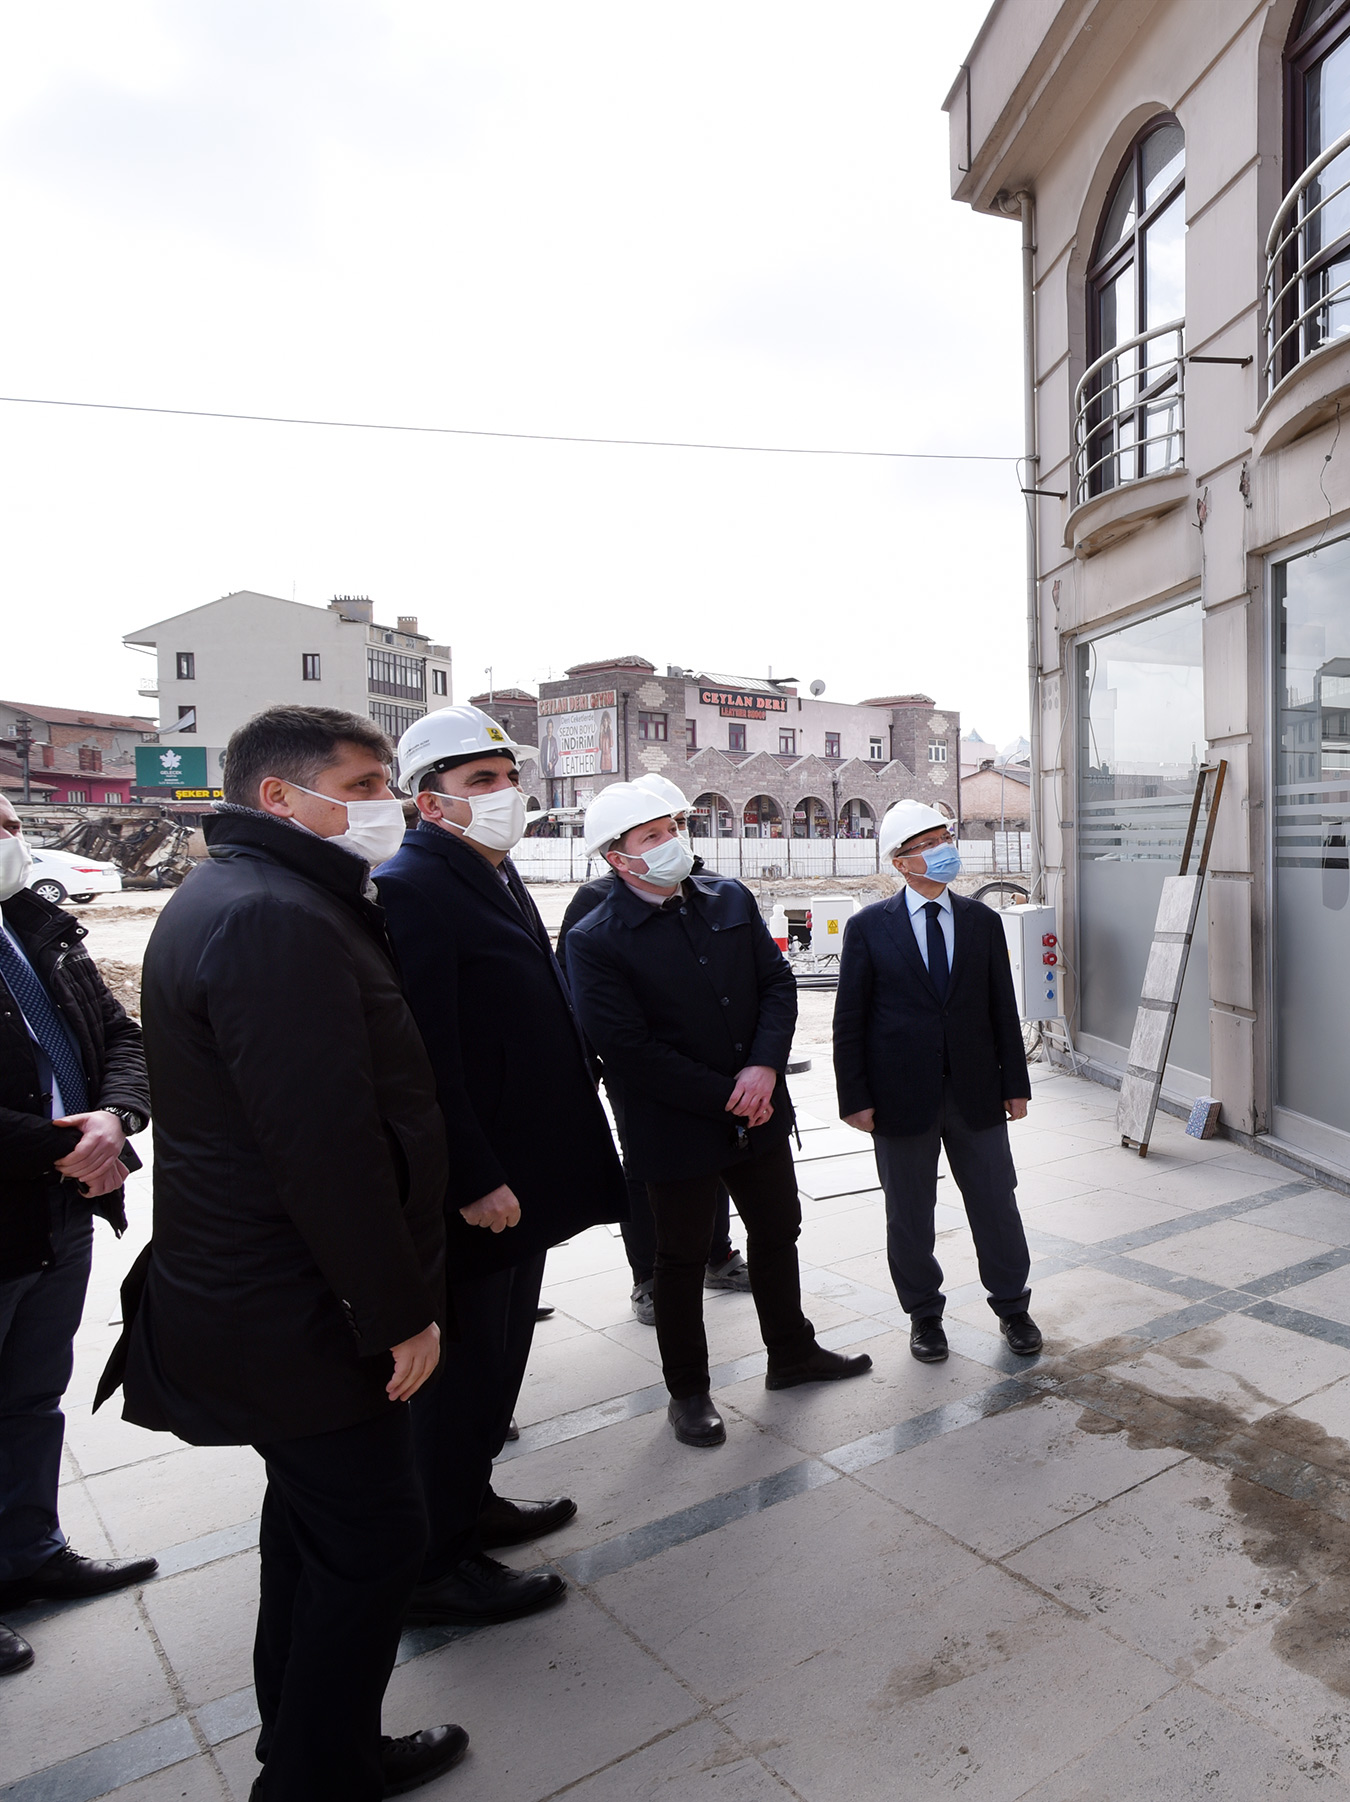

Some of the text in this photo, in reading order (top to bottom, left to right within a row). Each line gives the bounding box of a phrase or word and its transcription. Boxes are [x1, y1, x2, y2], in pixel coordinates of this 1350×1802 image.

[539, 698, 568, 715] CEYLAN
[702, 692, 787, 711] CEYLAN DERİ
[559, 723, 596, 737] SEZON BOYU
[562, 754, 595, 775] LEATHER
[175, 789, 210, 800] ŞEKER
